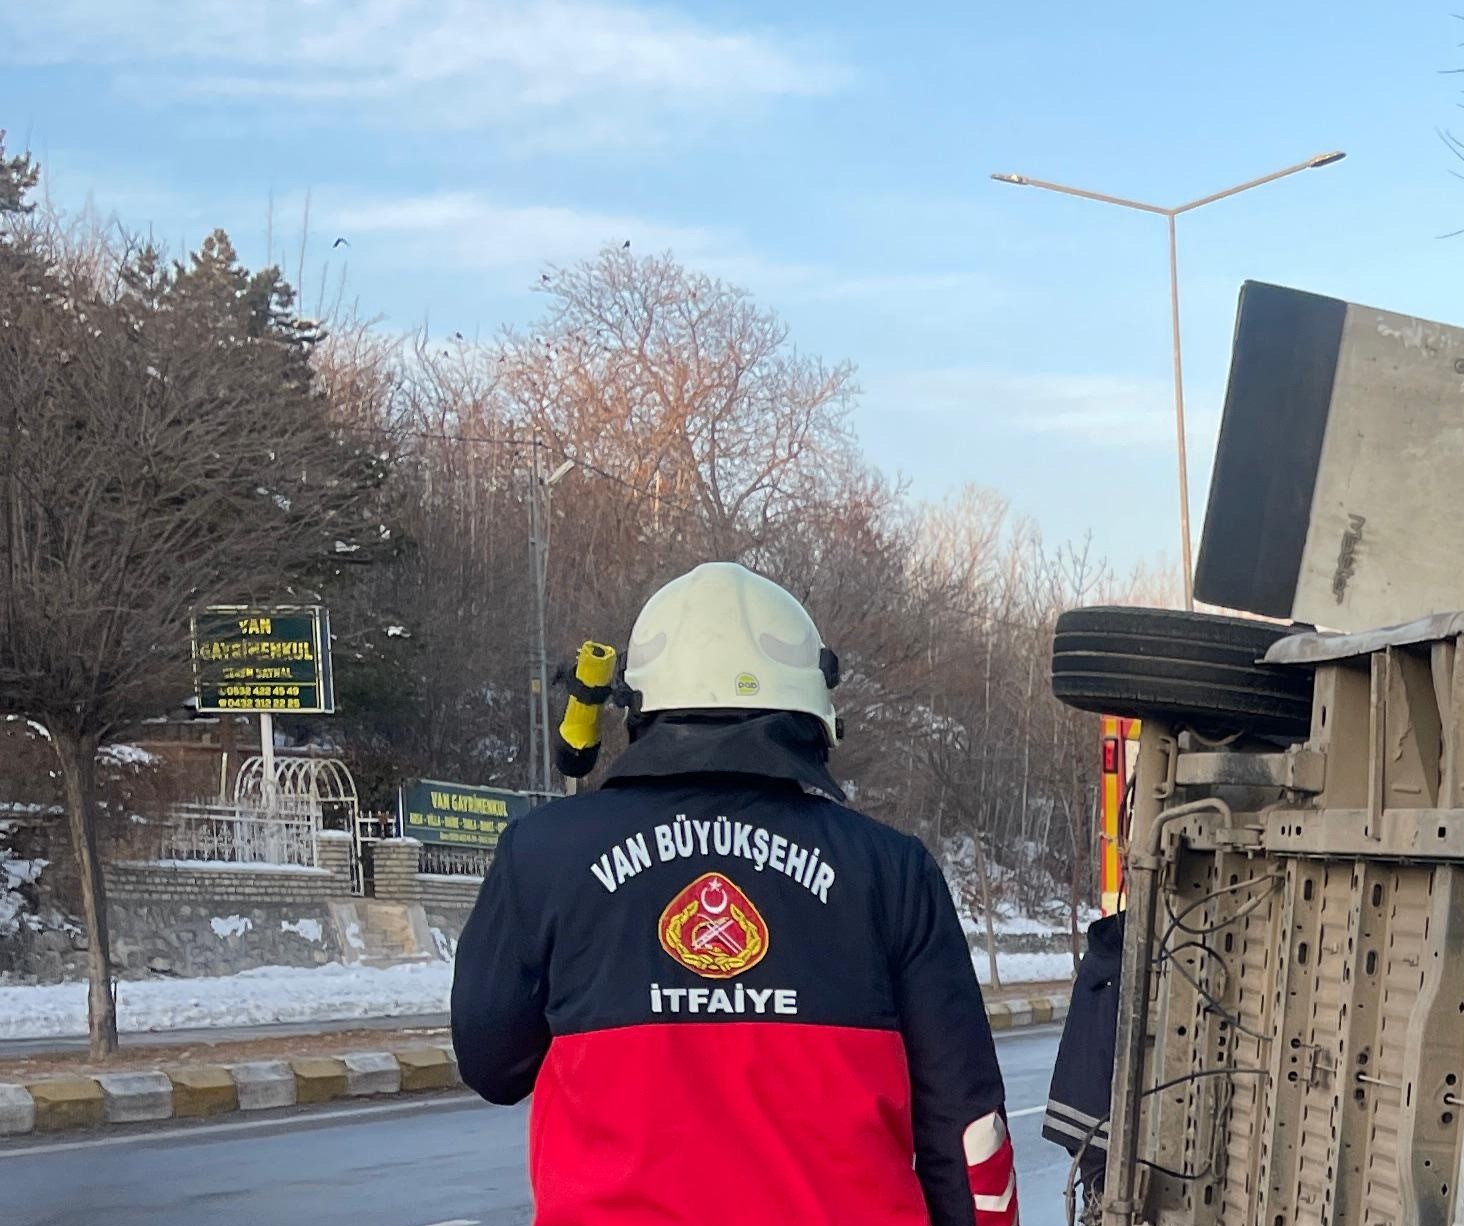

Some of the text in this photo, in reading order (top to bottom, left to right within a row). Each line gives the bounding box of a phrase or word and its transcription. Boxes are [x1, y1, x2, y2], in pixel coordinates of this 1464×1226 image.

[239, 618, 271, 634] VAN
[431, 791, 450, 810] VAN
[590, 814, 835, 904] VAN BÜYÜKŞEHİR
[650, 982, 798, 1015] İTFAİYE
